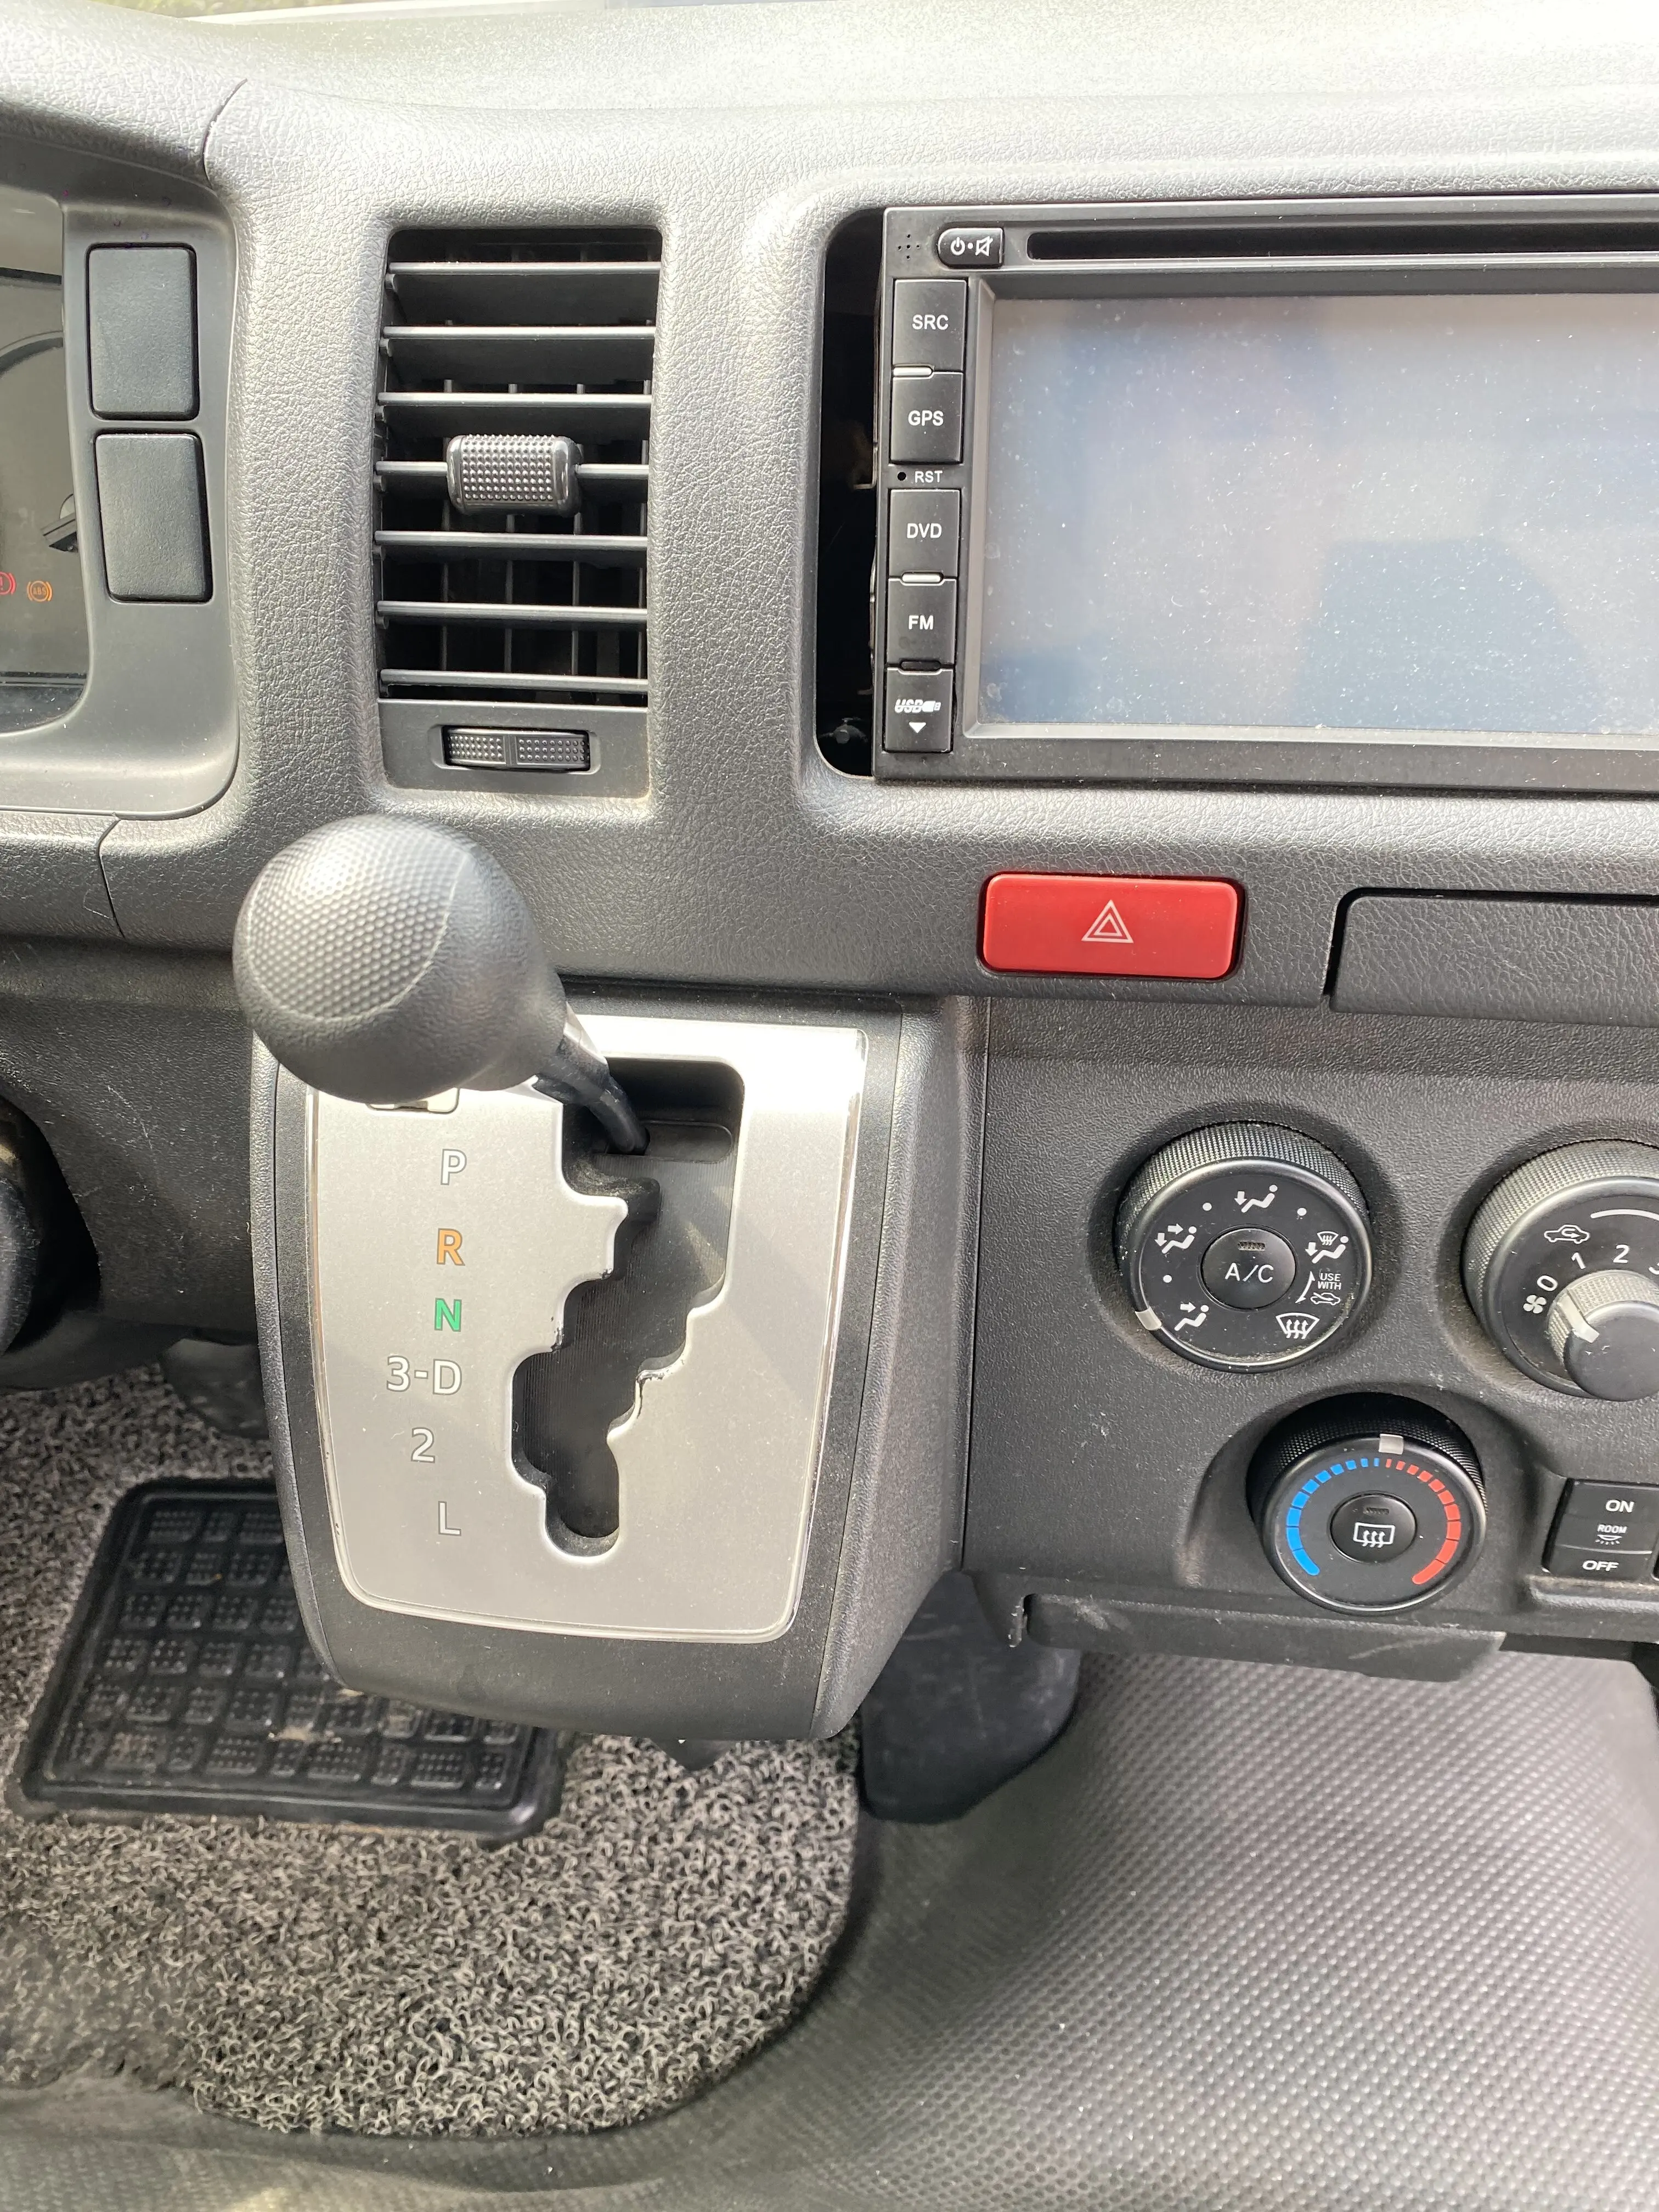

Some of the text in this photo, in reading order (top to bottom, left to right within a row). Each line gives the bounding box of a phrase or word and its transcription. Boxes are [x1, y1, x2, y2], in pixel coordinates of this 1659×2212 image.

[912, 314, 949, 330] SRC
[908, 410, 944, 426] GPS
[914, 470, 943, 483] RST
[906, 523, 942, 539] DVD
[908, 615, 934, 630] FM
[894, 699, 924, 713] USB
[440, 1149, 466, 1186] P
[436, 1228, 465, 1266] R
[1571, 1252, 1587, 1269] 1
[1613, 1244, 1630, 1263] 2
[1224, 1262, 1274, 1284] A/C
[1319, 1272, 1341, 1282] USE
[1317, 1281, 1342, 1291] WITH
[434, 1298, 462, 1332] N
[386, 1356, 462, 1396] 3-D
[411, 1429, 435, 1463] 2
[1605, 1499, 1635, 1514] ON
[438, 1501, 462, 1536] L
[1597, 1523, 1628, 1534] ROOM
[1582, 1560, 1620, 1572] OFF
